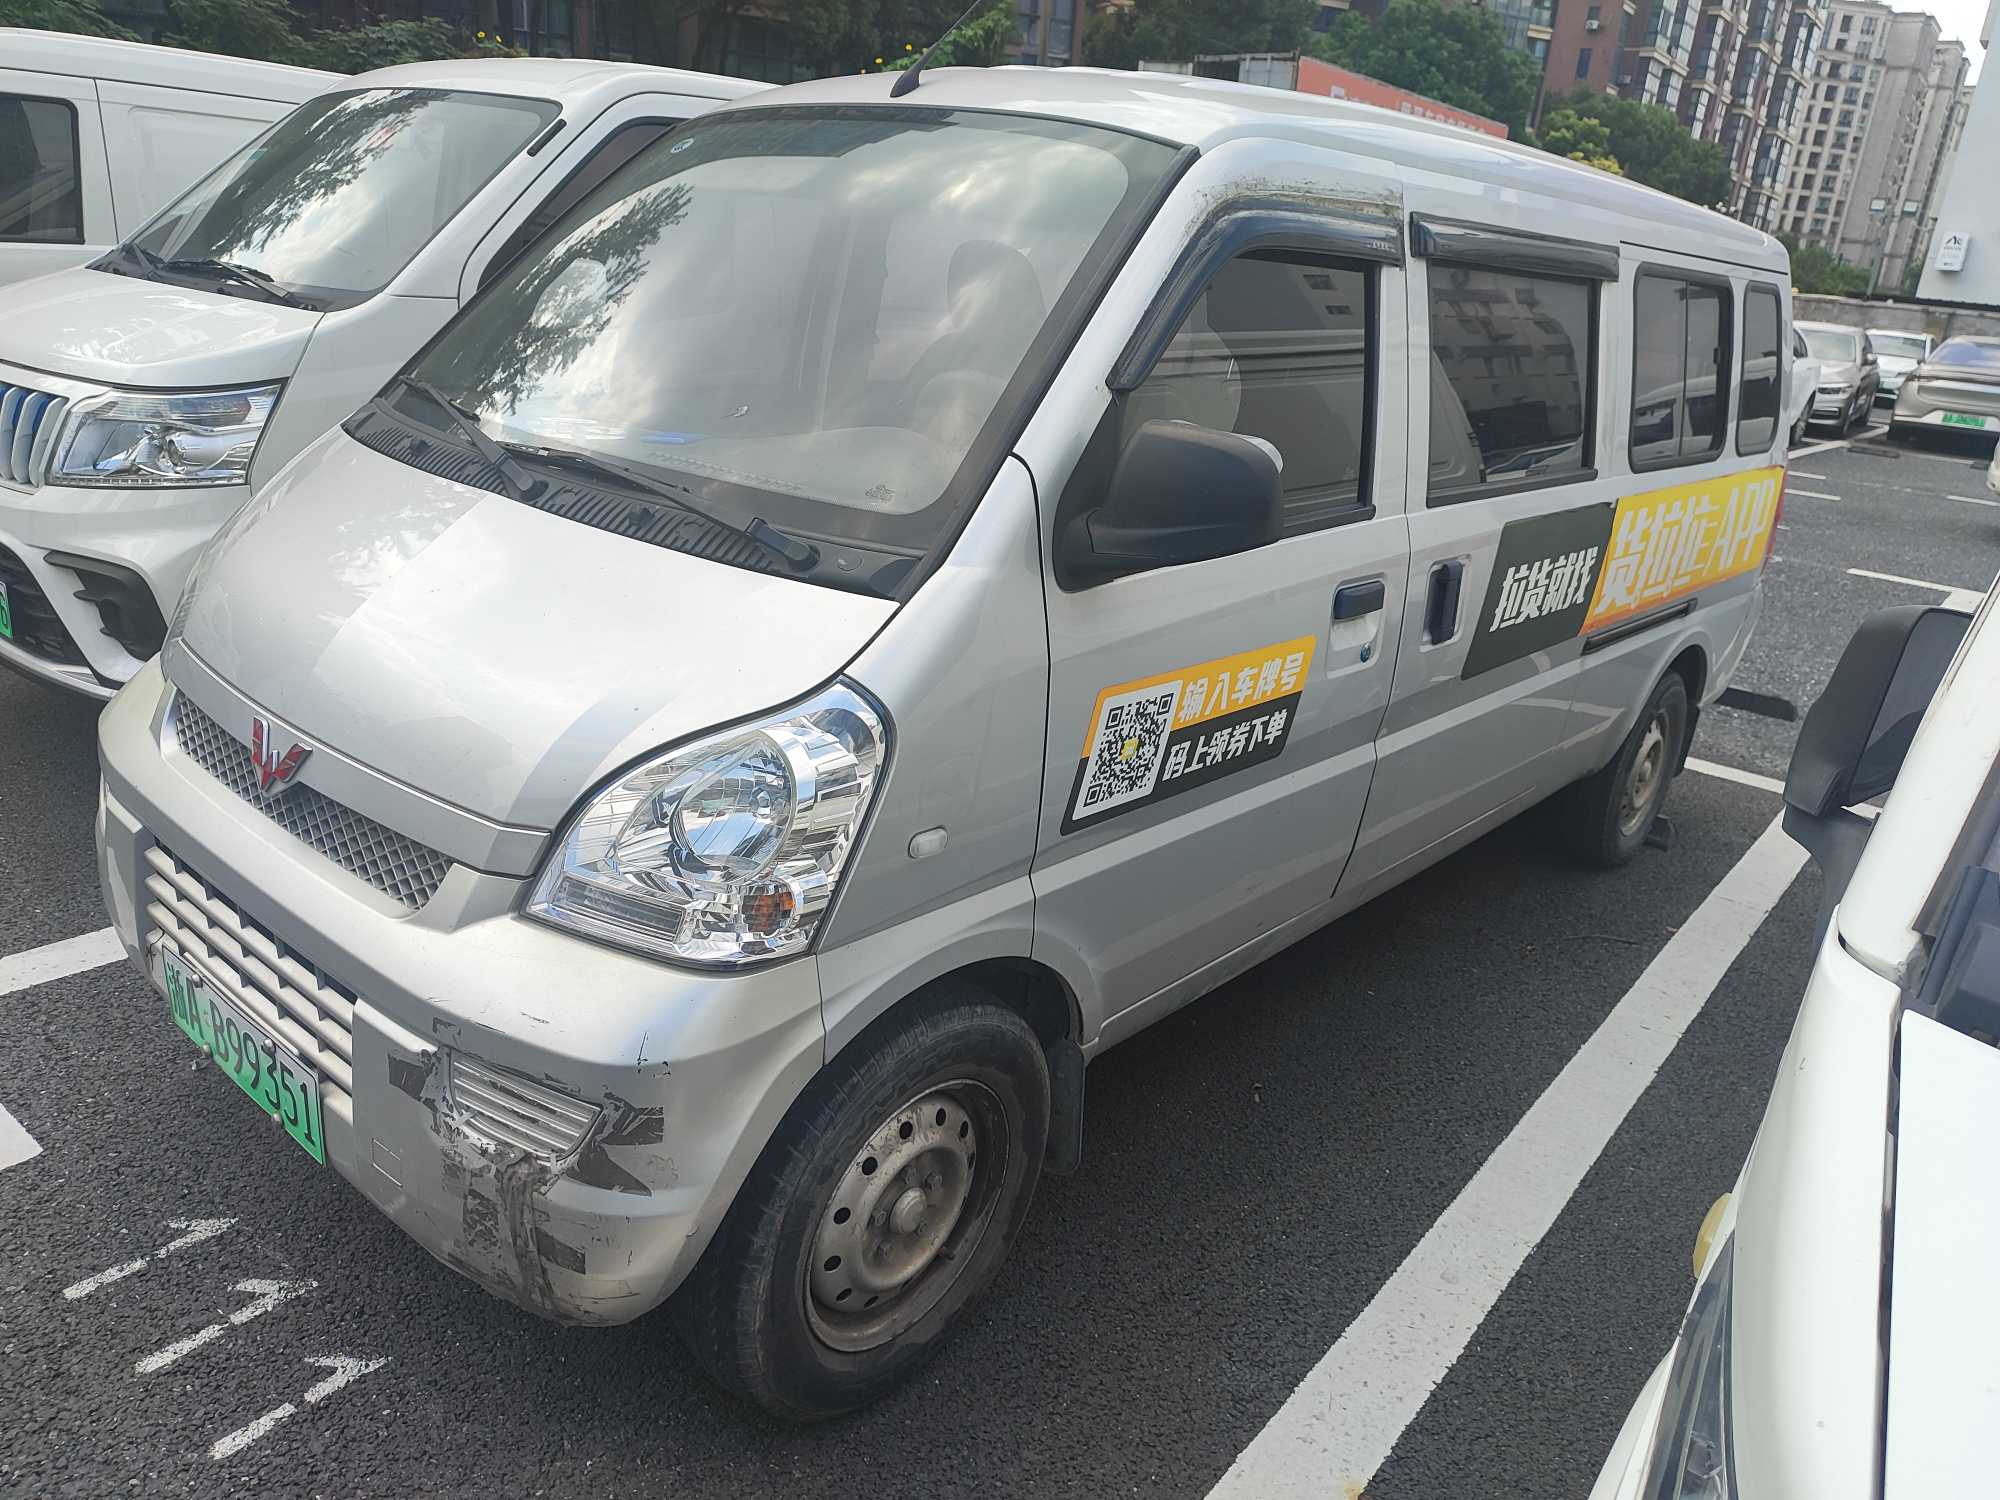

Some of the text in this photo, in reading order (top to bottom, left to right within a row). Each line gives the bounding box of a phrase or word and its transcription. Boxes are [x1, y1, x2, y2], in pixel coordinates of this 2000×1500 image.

[1489, 546, 1599, 633] 拉货就找
[1178, 651, 1305, 723] 输入车牌号
[1161, 708, 1288, 782] 码上领券下单
